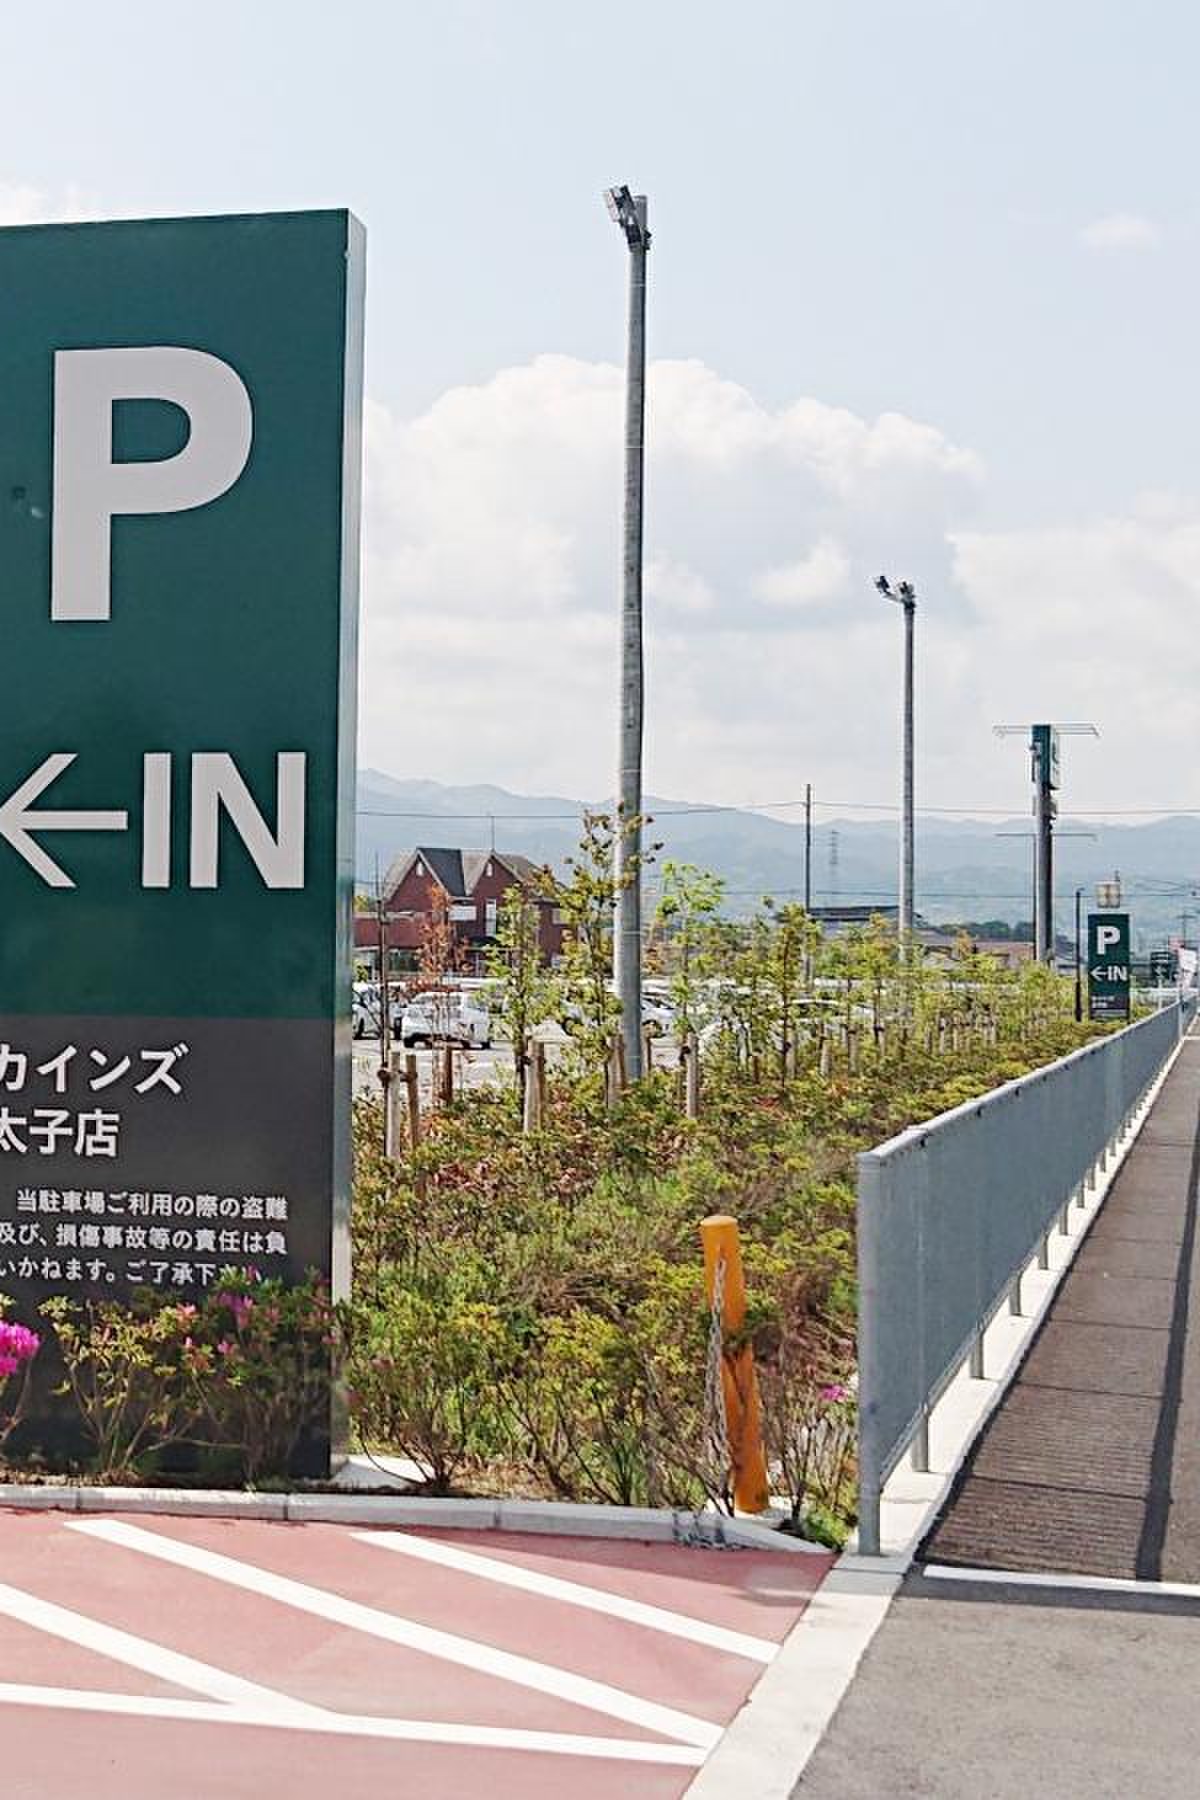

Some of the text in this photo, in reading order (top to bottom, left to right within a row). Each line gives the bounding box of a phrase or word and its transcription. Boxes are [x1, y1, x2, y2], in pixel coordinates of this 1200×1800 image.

[51, 346, 254, 622] P
[141, 750, 307, 889] IN
[1096, 925, 1121, 956] P
[1107, 965, 1128, 982] IN
[16, 1189, 288, 1221] 当駐車場ご利用の際の盗難
